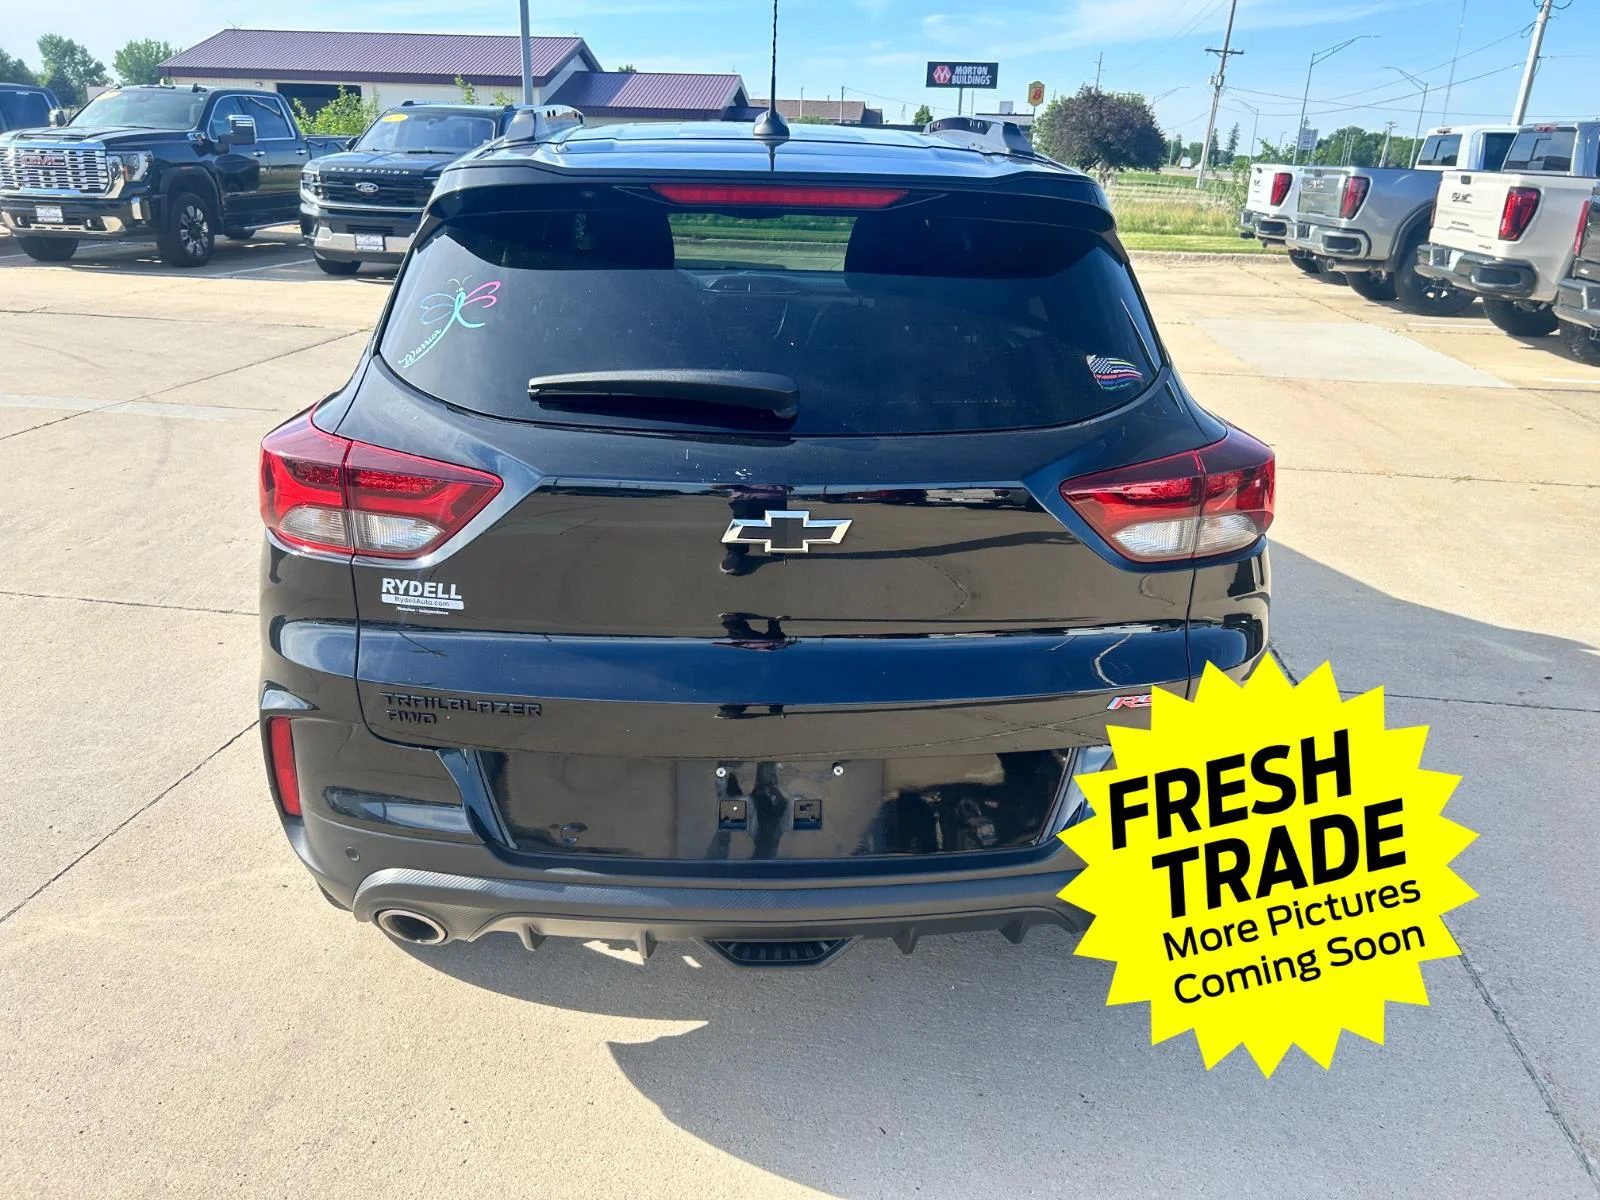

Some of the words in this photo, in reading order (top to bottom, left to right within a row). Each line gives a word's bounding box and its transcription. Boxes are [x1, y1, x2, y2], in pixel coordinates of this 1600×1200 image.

[954, 66, 989, 75] MORTON
[951, 75, 991, 85] BUILDINGS
[1032, 89, 1042, 100] 8
[330, 167, 410, 175] EXPEDITION
[382, 577, 463, 600] RYDELL
[394, 596, 450, 607] RydellAuto.com
[379, 692, 543, 717] TRAILBLAZER
[386, 710, 438, 725] AWD
